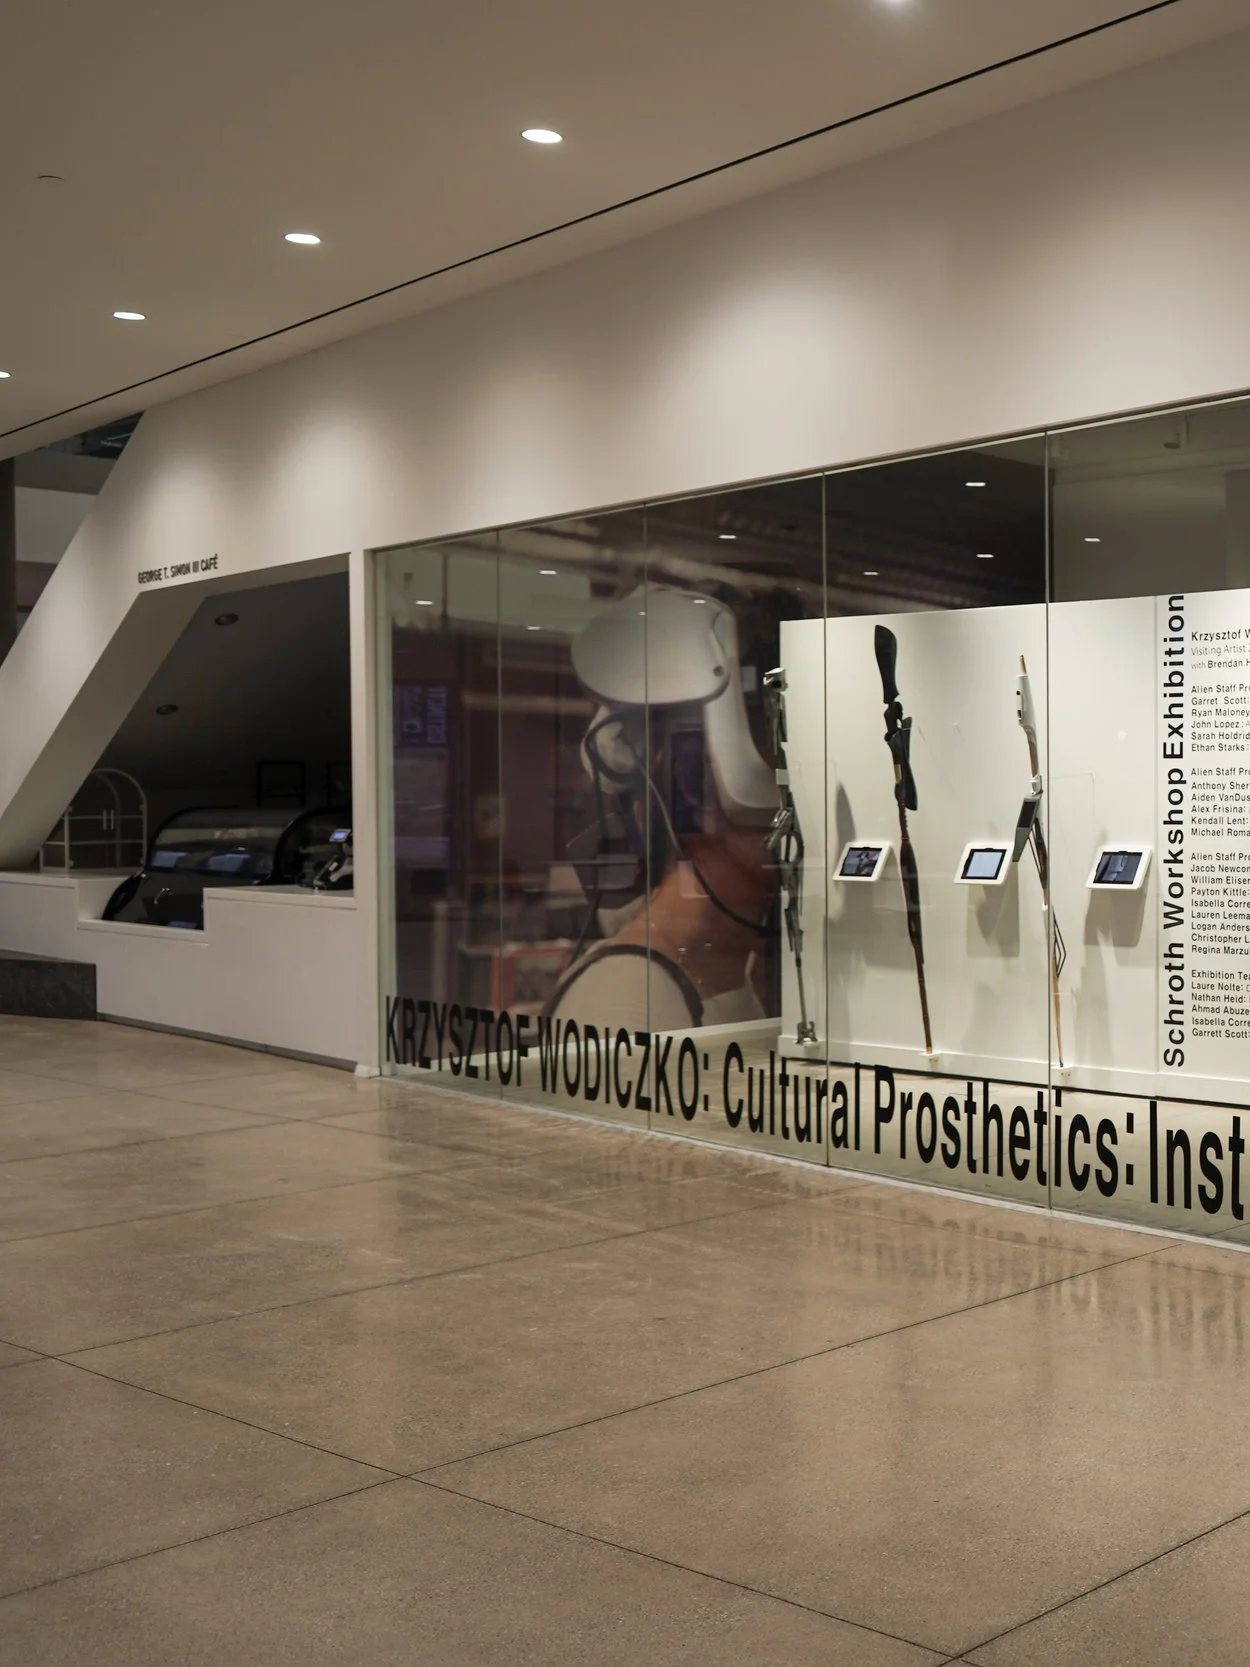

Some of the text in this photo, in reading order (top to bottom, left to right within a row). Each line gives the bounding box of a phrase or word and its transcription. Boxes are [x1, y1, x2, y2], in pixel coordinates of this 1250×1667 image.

[138, 568, 162, 584] GEORGE
[170, 562, 191, 578] SIMON
[201, 553, 218, 571] CAFÉ
[1191, 627, 1241, 641] Krzysztof
[1191, 646, 1221, 656] Visiting
[1224, 644, 1246, 654] Artist
[1191, 661, 1206, 669] with
[1208, 659, 1243, 669] Brendan
[1191, 685, 1213, 694] Alien
[1216, 684, 1236, 693] Staff
[1191, 697, 1218, 705] Garret
[1224, 696, 1250, 704] Scott:
[1191, 709, 1212, 718] Ryan
[1191, 720, 1211, 728] John
[1191, 732, 1216, 740] Sarah
[1191, 743, 1215, 752] Ethan
[1191, 768, 1213, 776] Alien
[1216, 768, 1236, 776] Staff
[1191, 782, 1226, 791] Anthony
[1191, 805, 1210, 813] Alex
[1213, 805, 1246, 813] Frisina:
[1191, 817, 1224, 825] Kendall
[1227, 817, 1248, 825] Lent:
[1163, 595, 1187, 1067] Schroth Workshop Exhibition
[1191, 828, 1224, 837] Michael
[1191, 853, 1213, 861] Alien
[1216, 853, 1236, 861] Staff
[1191, 876, 1223, 884] William
[1191, 888, 1220, 897] Payton
[1223, 888, 1250, 897] Kittle:
[1191, 900, 1225, 908] Isabella
[1191, 911, 1220, 919] Lauren
[1191, 922, 1217, 932] Logan
[1191, 934, 1242, 944] Christopher
[1192, 945, 1221, 955] Regina
[1191, 970, 1235, 980] Exhibition
[1191, 982, 1215, 991] Laure
[1218, 983, 1244, 992] Nolte:
[1191, 993, 1221, 1002] Nathan
[1224, 995, 1246, 1003] Heid:
[1192, 1004, 1220, 1014] Ahmad
[1192, 1017, 1226, 1026] Isabella
[1192, 1028, 1222, 1038] Garrett
[1225, 1030, 1250, 1038] Scott:
[385, 996, 530, 1087] KRZYSZTOF
[537, 1015, 709, 1121] WODICZKO:
[723, 1041, 861, 1151] Cultural
[874, 1064, 1135, 1198] Prosthetics:
